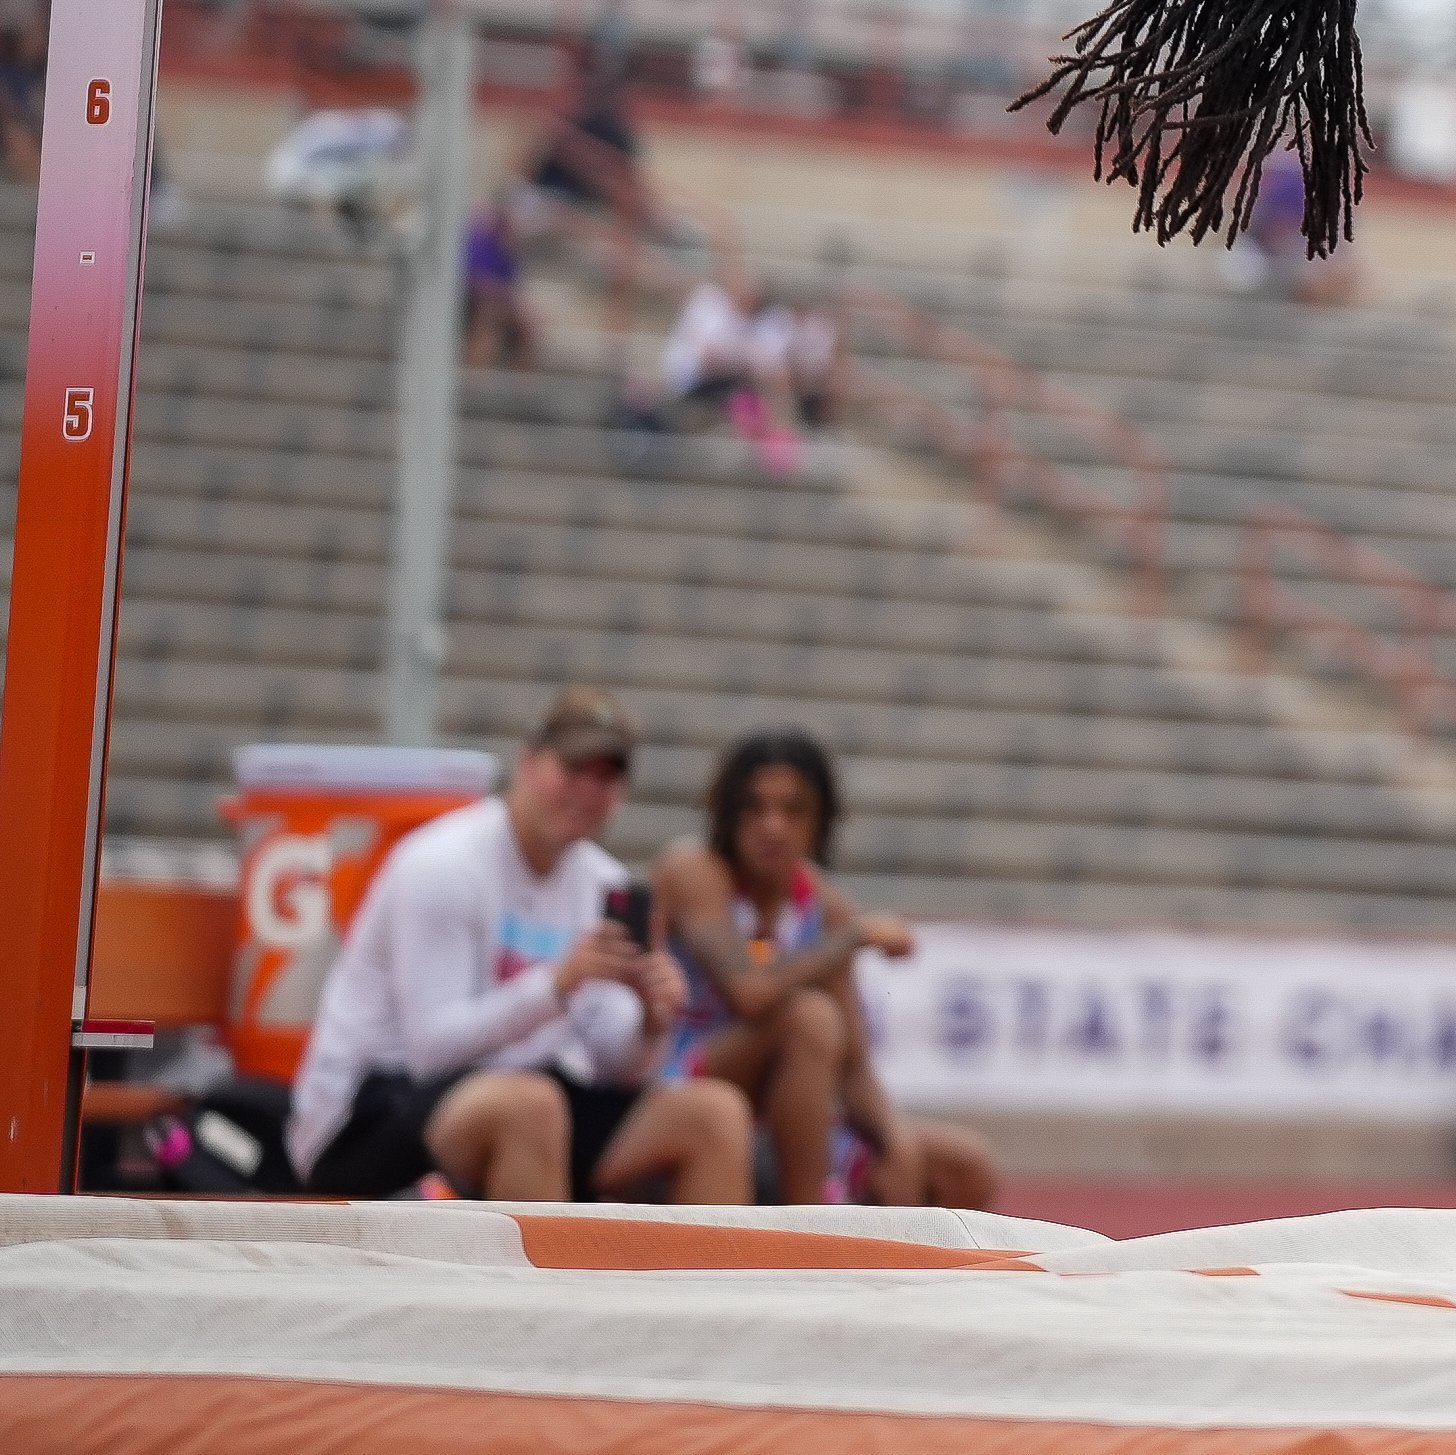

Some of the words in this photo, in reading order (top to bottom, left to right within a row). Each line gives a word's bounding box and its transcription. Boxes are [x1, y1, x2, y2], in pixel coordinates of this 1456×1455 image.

[86, 78, 112, 125] 6
[62, 387, 95, 442] 5
[248, 835, 331, 946] G
